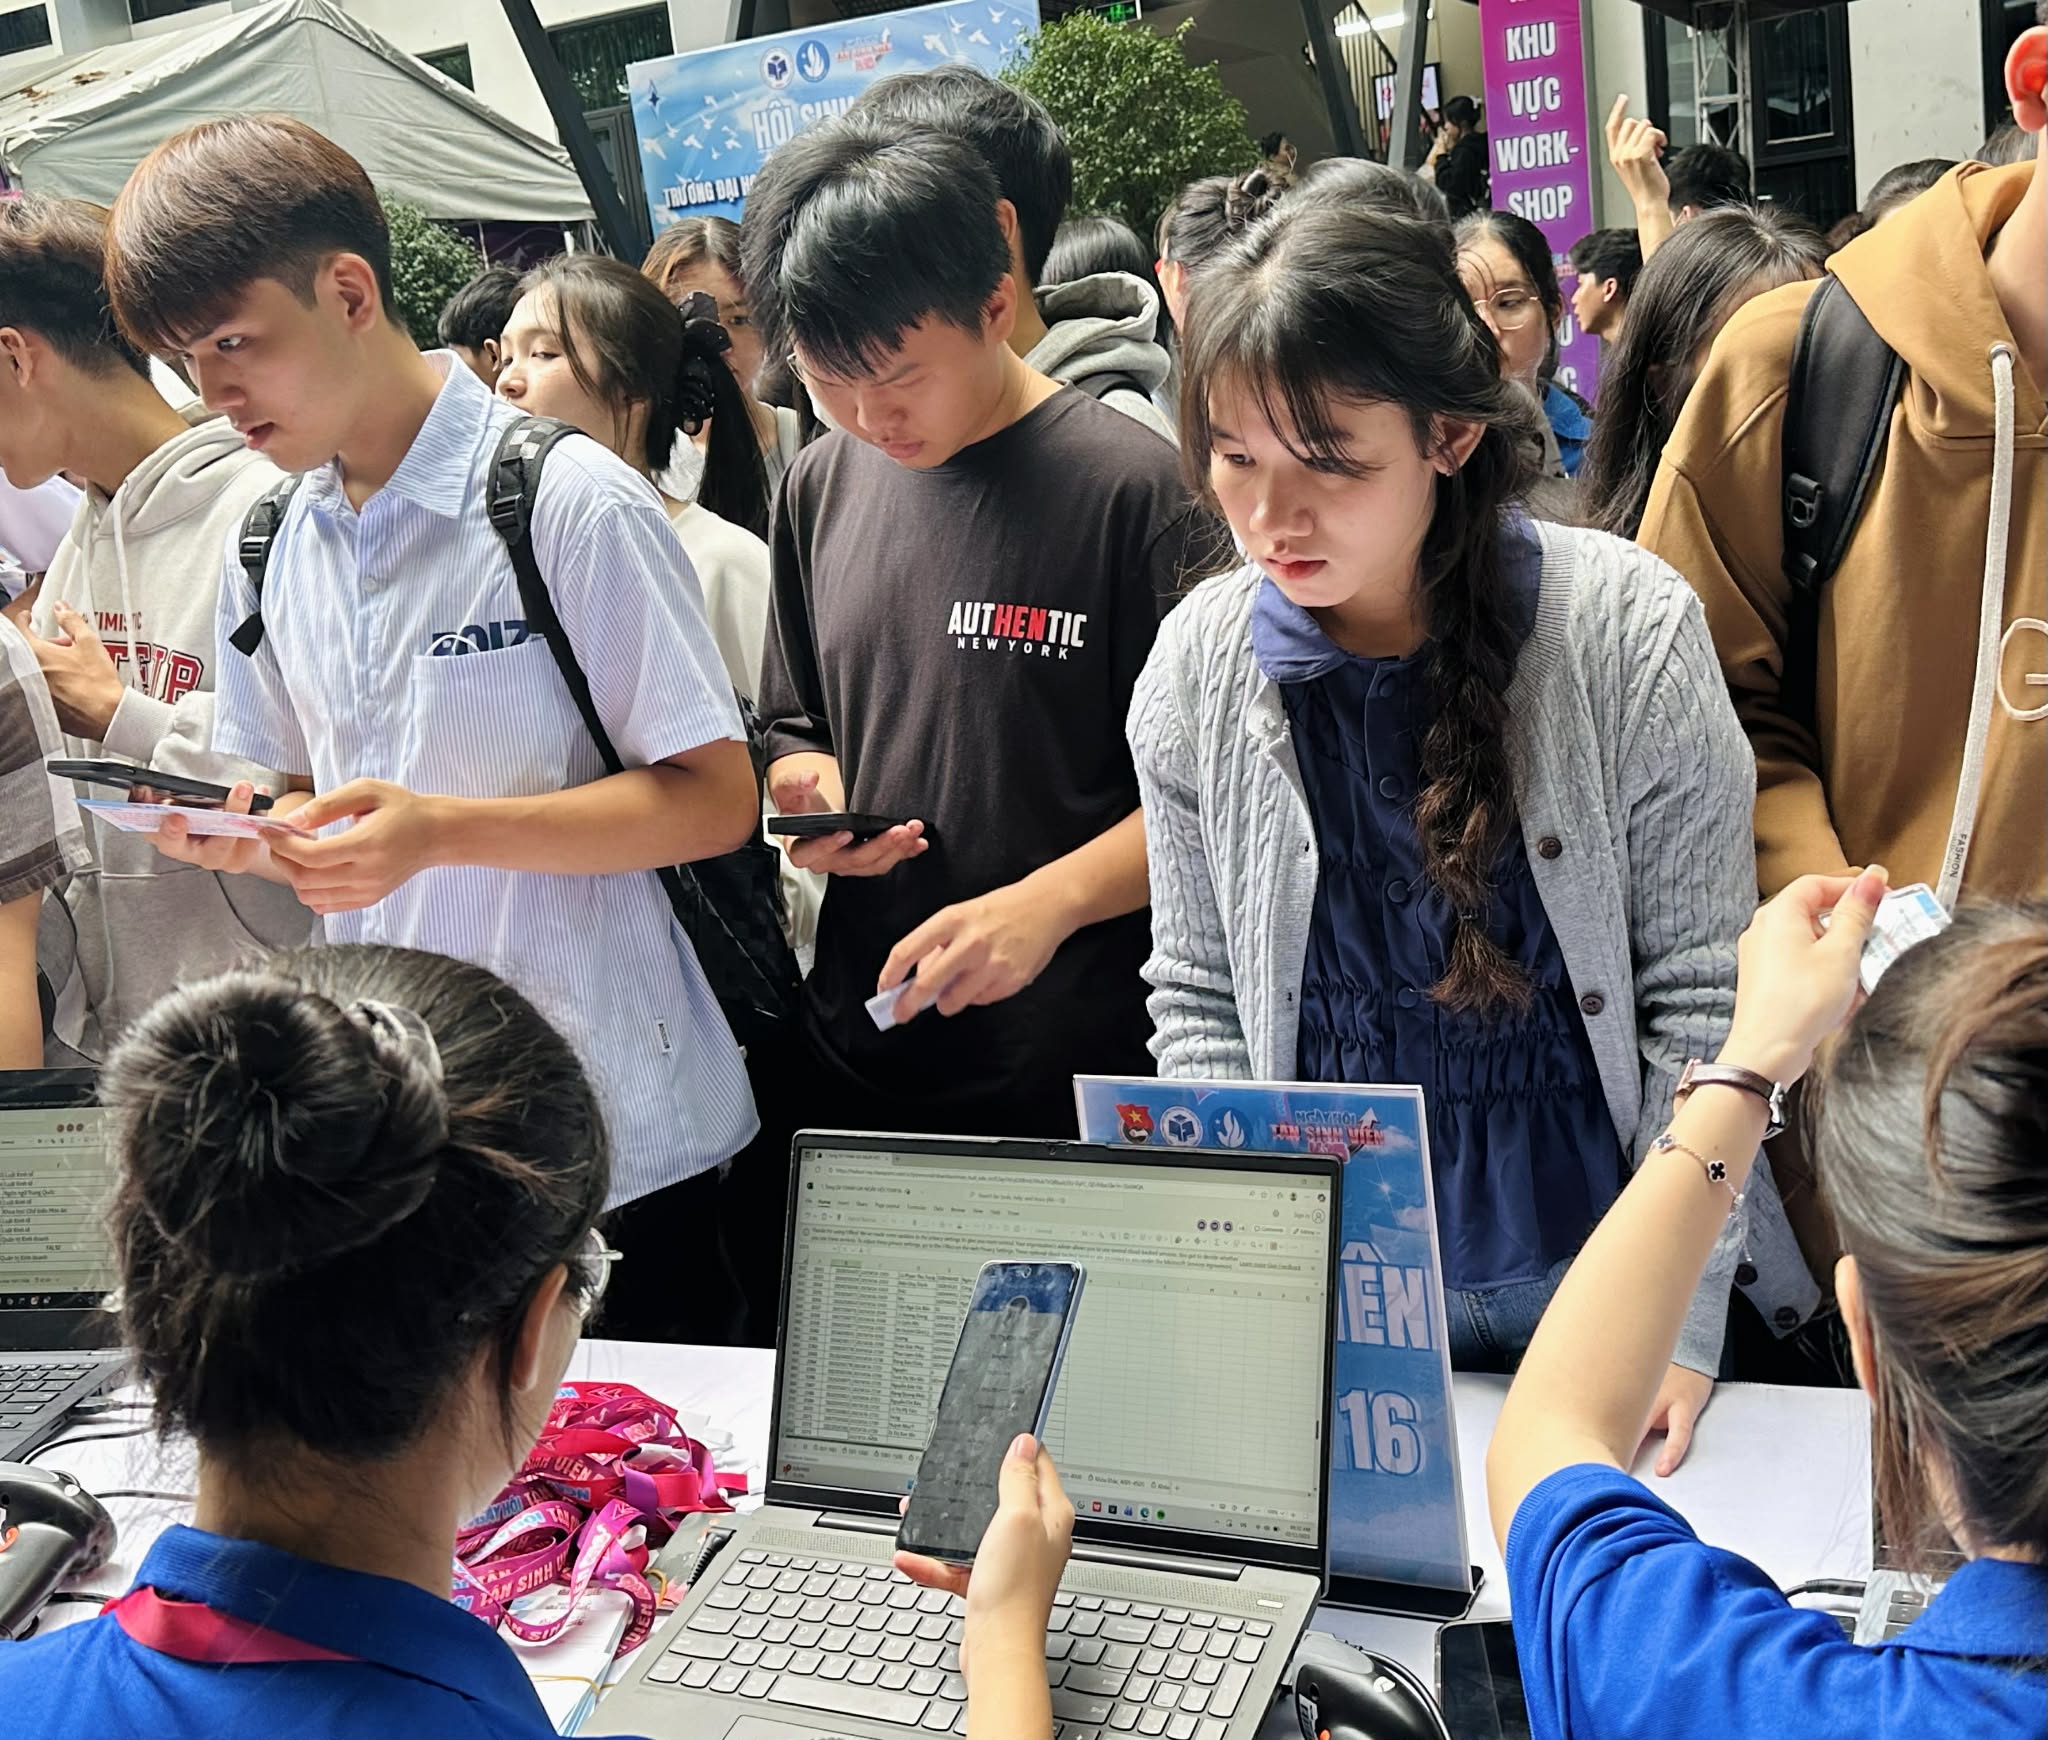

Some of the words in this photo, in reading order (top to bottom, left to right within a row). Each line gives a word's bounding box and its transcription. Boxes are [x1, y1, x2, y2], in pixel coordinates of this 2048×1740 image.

[1505, 21, 1557, 62] KHU
[1507, 76, 1561, 121] VỰC
[1495, 130, 1580, 173] WORK-
[1508, 184, 1573, 222] SHOP
[947, 601, 1087, 648] AUTHENTIC
[1949, 833, 1968, 878] FASHION
[1338, 1387, 1421, 1476] 16
[516, 1561, 553, 1593] SINH
